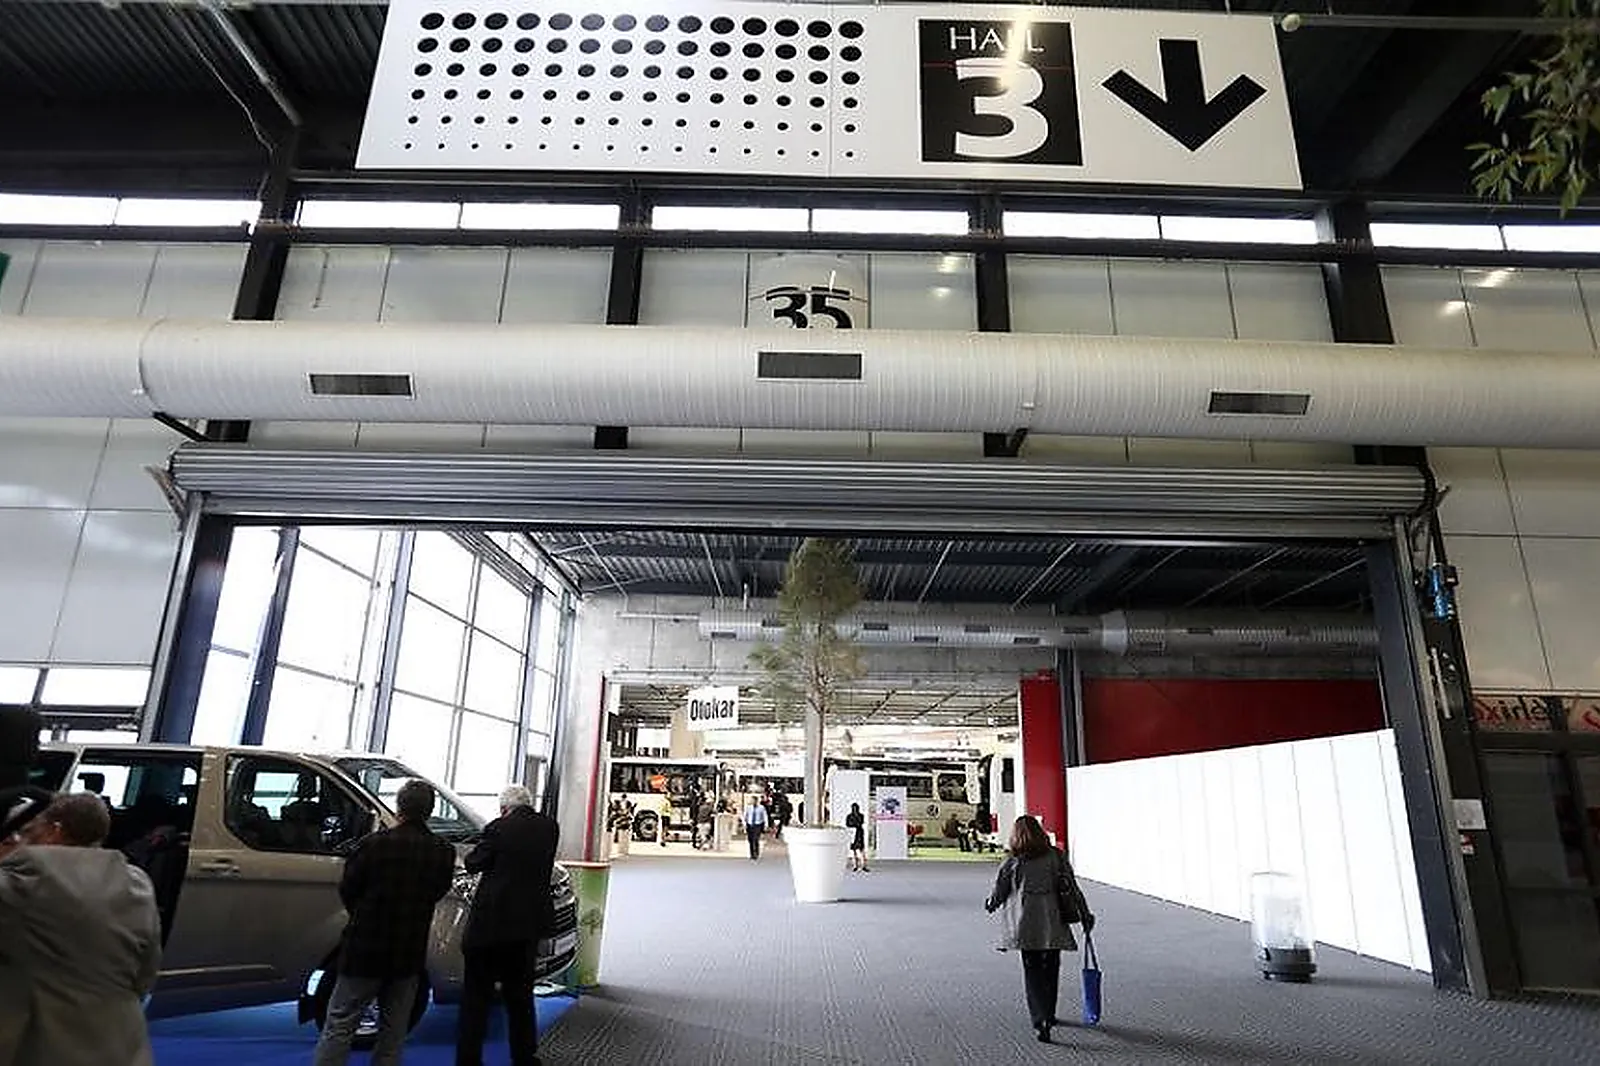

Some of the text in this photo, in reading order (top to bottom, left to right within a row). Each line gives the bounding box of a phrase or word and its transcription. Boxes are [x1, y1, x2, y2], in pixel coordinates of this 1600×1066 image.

[949, 27, 1046, 51] HALL
[955, 57, 1049, 158] 3
[766, 286, 853, 329] 35
